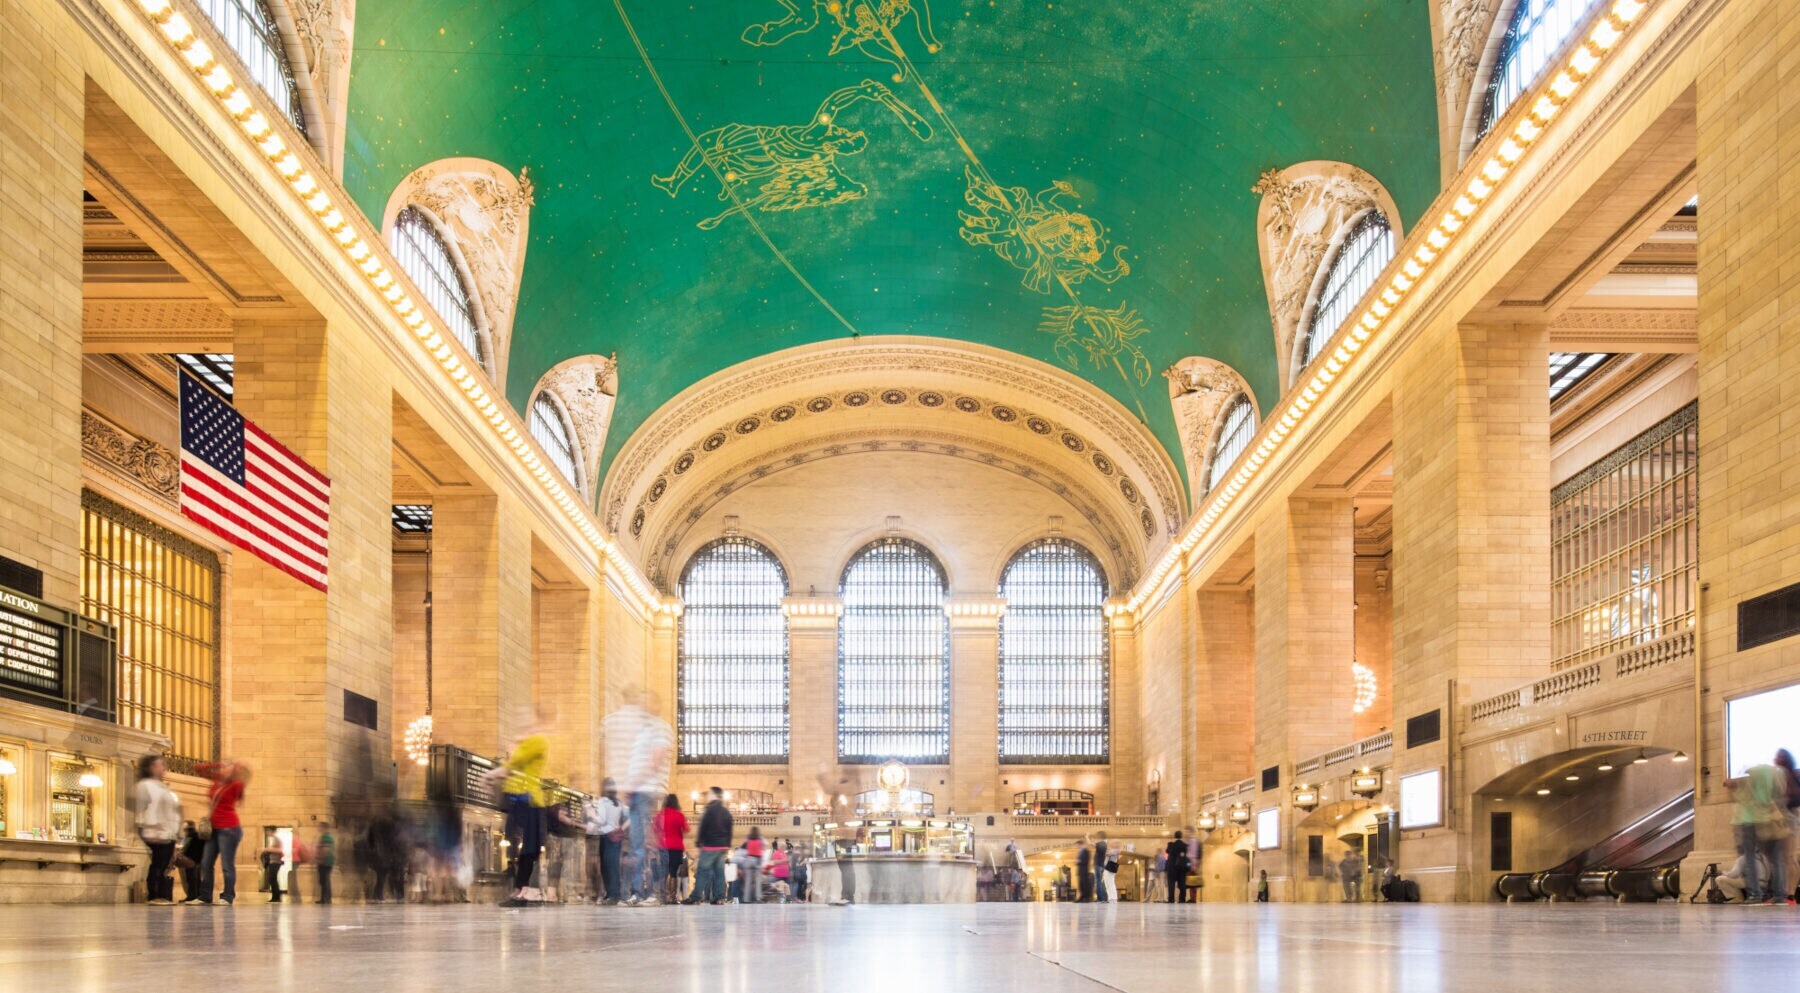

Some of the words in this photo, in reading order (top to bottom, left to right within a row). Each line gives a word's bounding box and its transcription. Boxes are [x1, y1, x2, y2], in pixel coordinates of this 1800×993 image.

[16, 627, 56, 647] UNATTENDED
[28, 642, 56, 657] REMOVED
[80, 735, 103, 745] TOURS
[1583, 732, 1606, 743] 45TH
[1608, 730, 1648, 741] STREET
